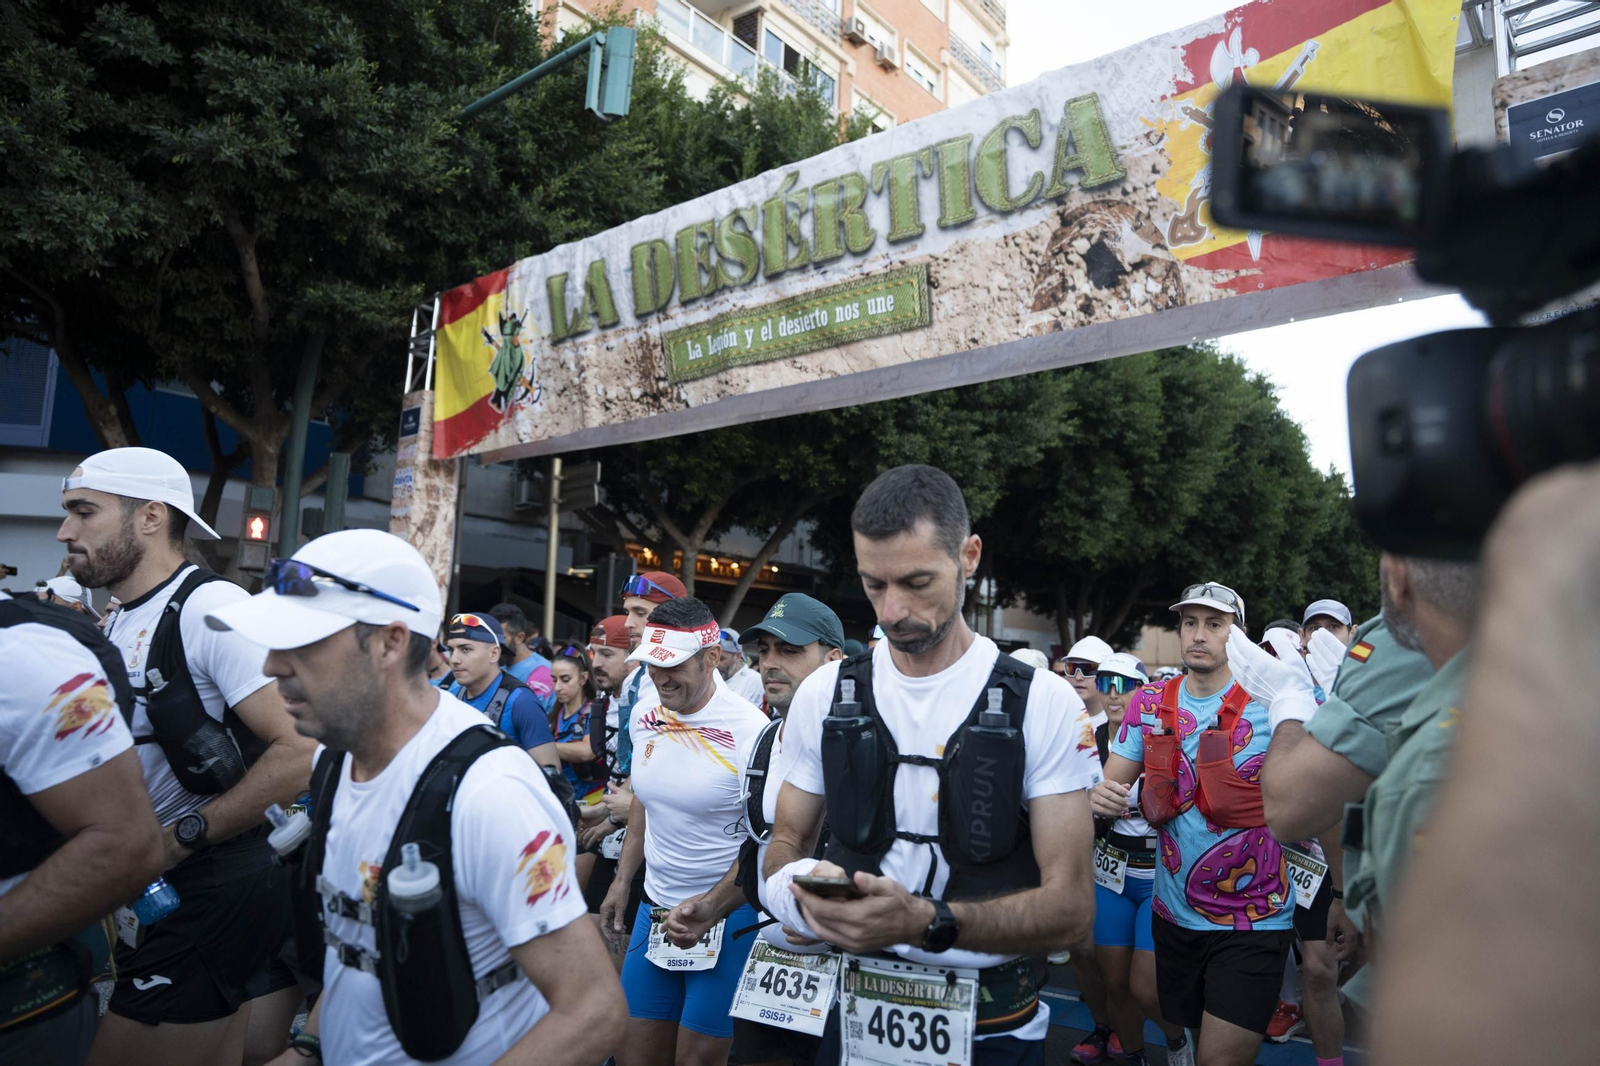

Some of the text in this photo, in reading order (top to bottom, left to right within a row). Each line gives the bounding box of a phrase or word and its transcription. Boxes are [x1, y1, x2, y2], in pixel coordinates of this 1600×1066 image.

[1529, 119, 1584, 140] SENATOR
[1536, 135, 1554, 143] HOTELS
[1558, 129, 1579, 137] RESORTS
[546, 91, 1128, 347] LA DESÉRTICA
[686, 294, 895, 361] La Legión y el desierto nos une
[655, 646, 676, 659] SWIM
[970, 755, 998, 864] KIPRUN
[1095, 849, 1118, 876] 502
[759, 966, 820, 1003] 4635
[863, 976, 878, 992] LA
[867, 1004, 951, 1055] 4636
